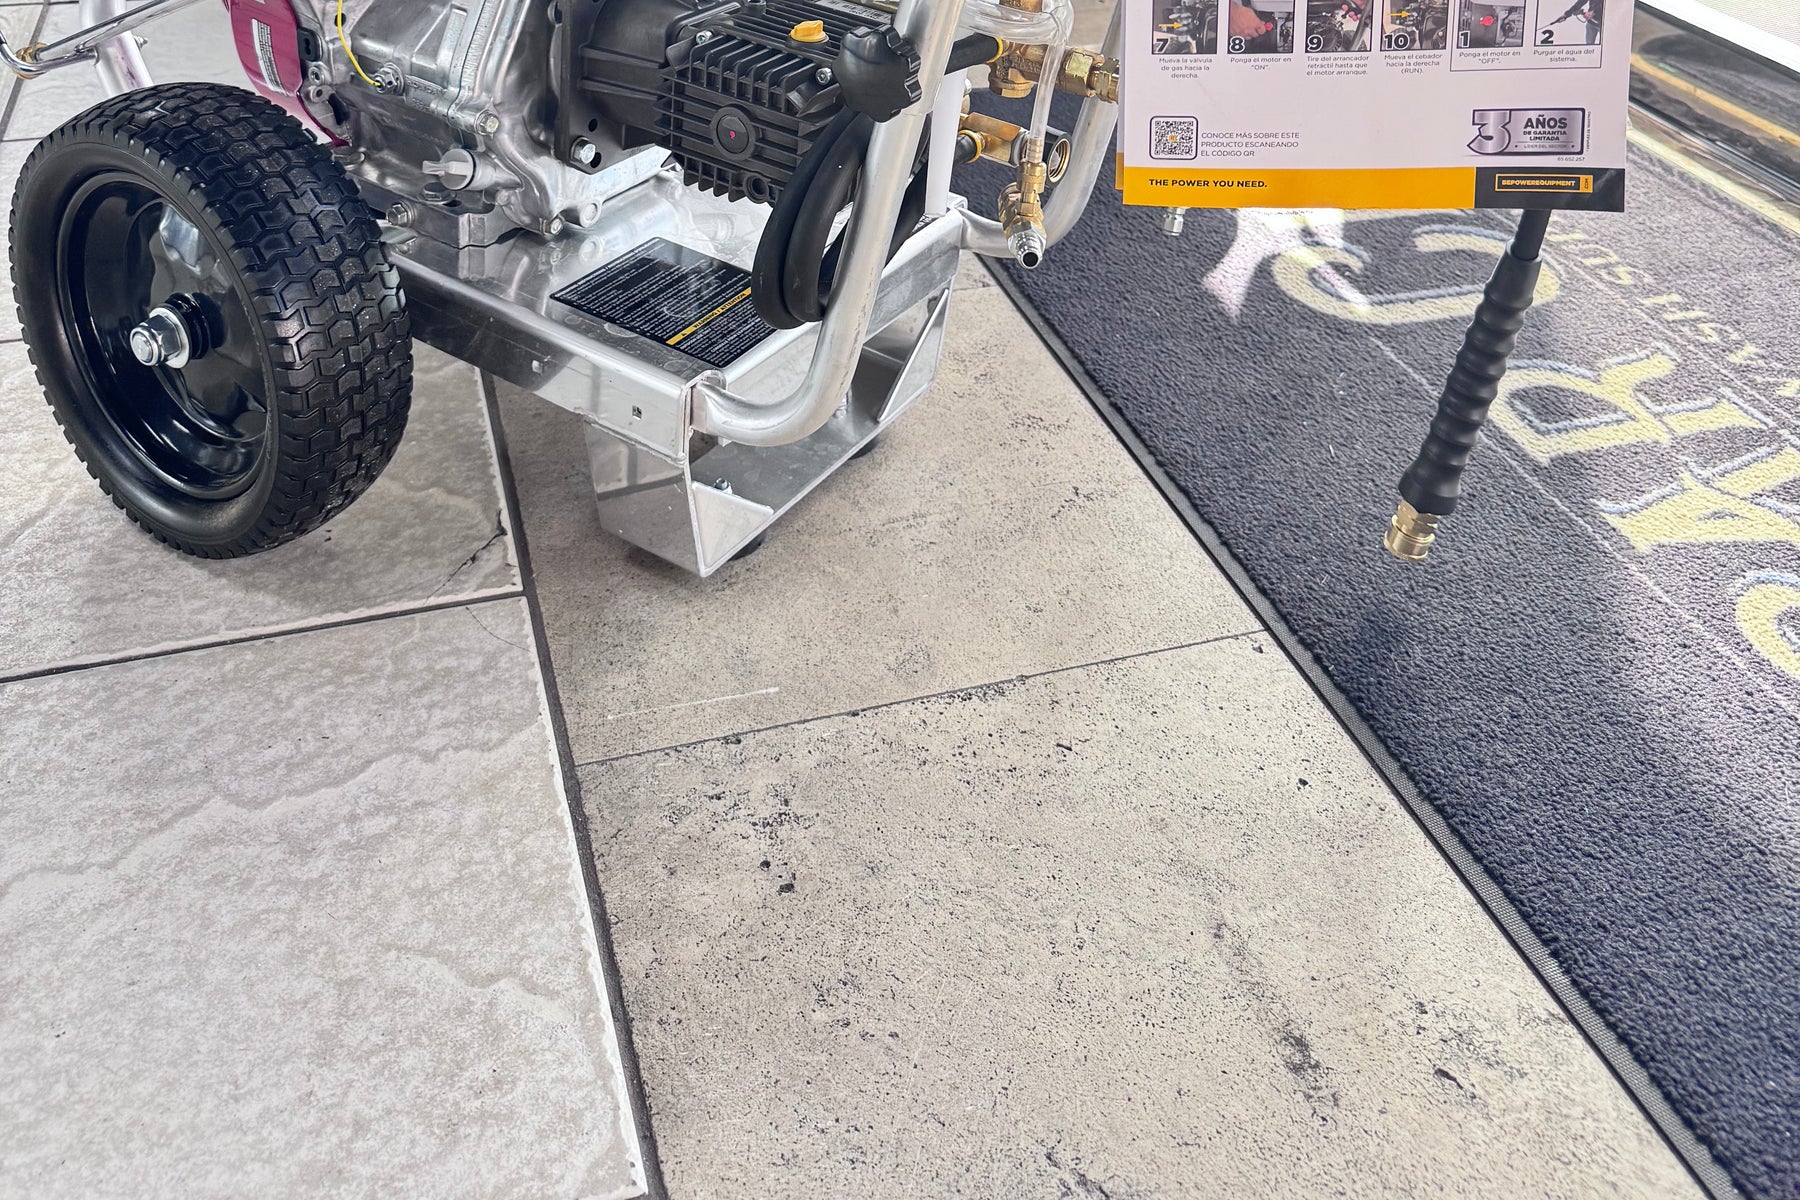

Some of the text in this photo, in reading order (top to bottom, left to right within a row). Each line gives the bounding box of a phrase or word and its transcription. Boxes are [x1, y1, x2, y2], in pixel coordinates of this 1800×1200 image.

[1230, 37, 1244, 52] 8
[1307, 35, 1322, 51] 9
[1384, 34, 1409, 49] 10
[1461, 32, 1470, 47] 1
[1540, 30, 1554, 44] 2
[1156, 38, 1169, 53] 7
[1524, 114, 1567, 129] AÑOS
[1467, 108, 1511, 154] 3
